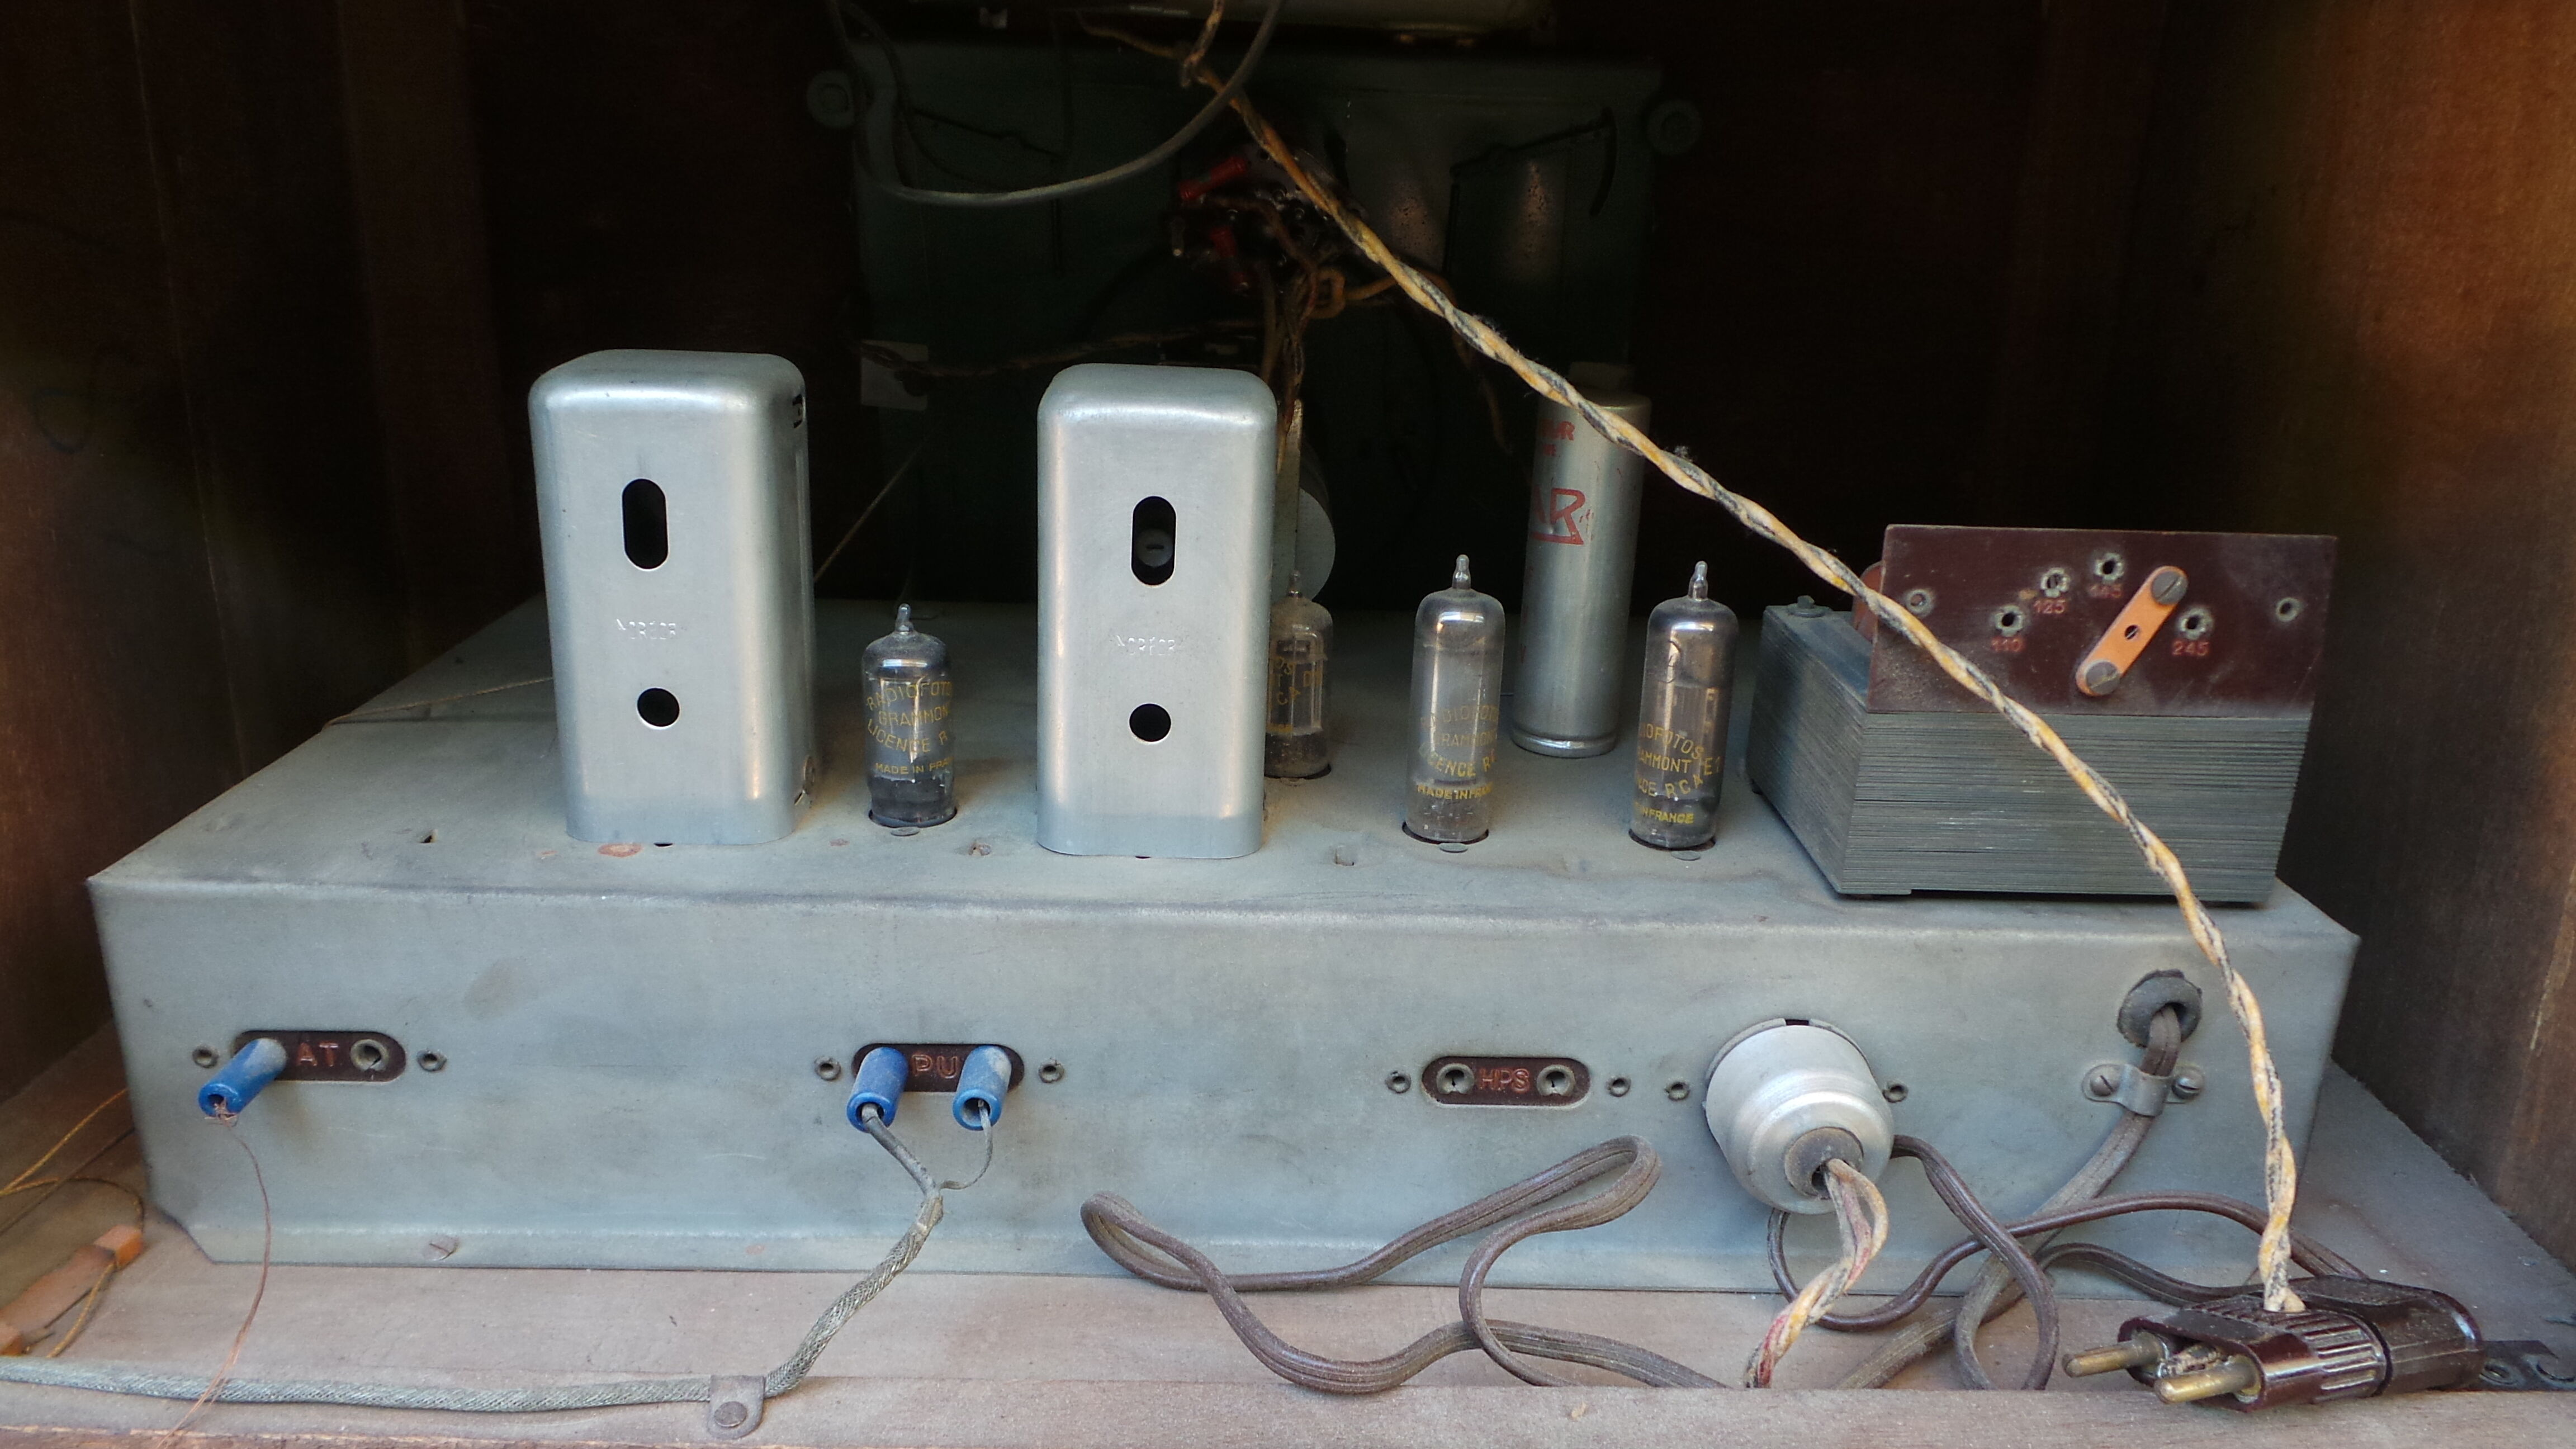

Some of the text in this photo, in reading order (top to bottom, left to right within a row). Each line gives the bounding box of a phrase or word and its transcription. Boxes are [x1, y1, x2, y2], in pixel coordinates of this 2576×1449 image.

[2034, 598, 2067, 614] 125
[1991, 638, 2023, 652] 110
[2172, 640, 2210, 656] 245
[868, 719, 930, 753] LICENCE
[1640, 724, 1704, 760] OFOTOS
[875, 763, 909, 775] MADE
[912, 765, 925, 774] IN
[296, 1041, 339, 1067] AT
[910, 1053, 960, 1079] PU
[1478, 1067, 1531, 1095] HPS
